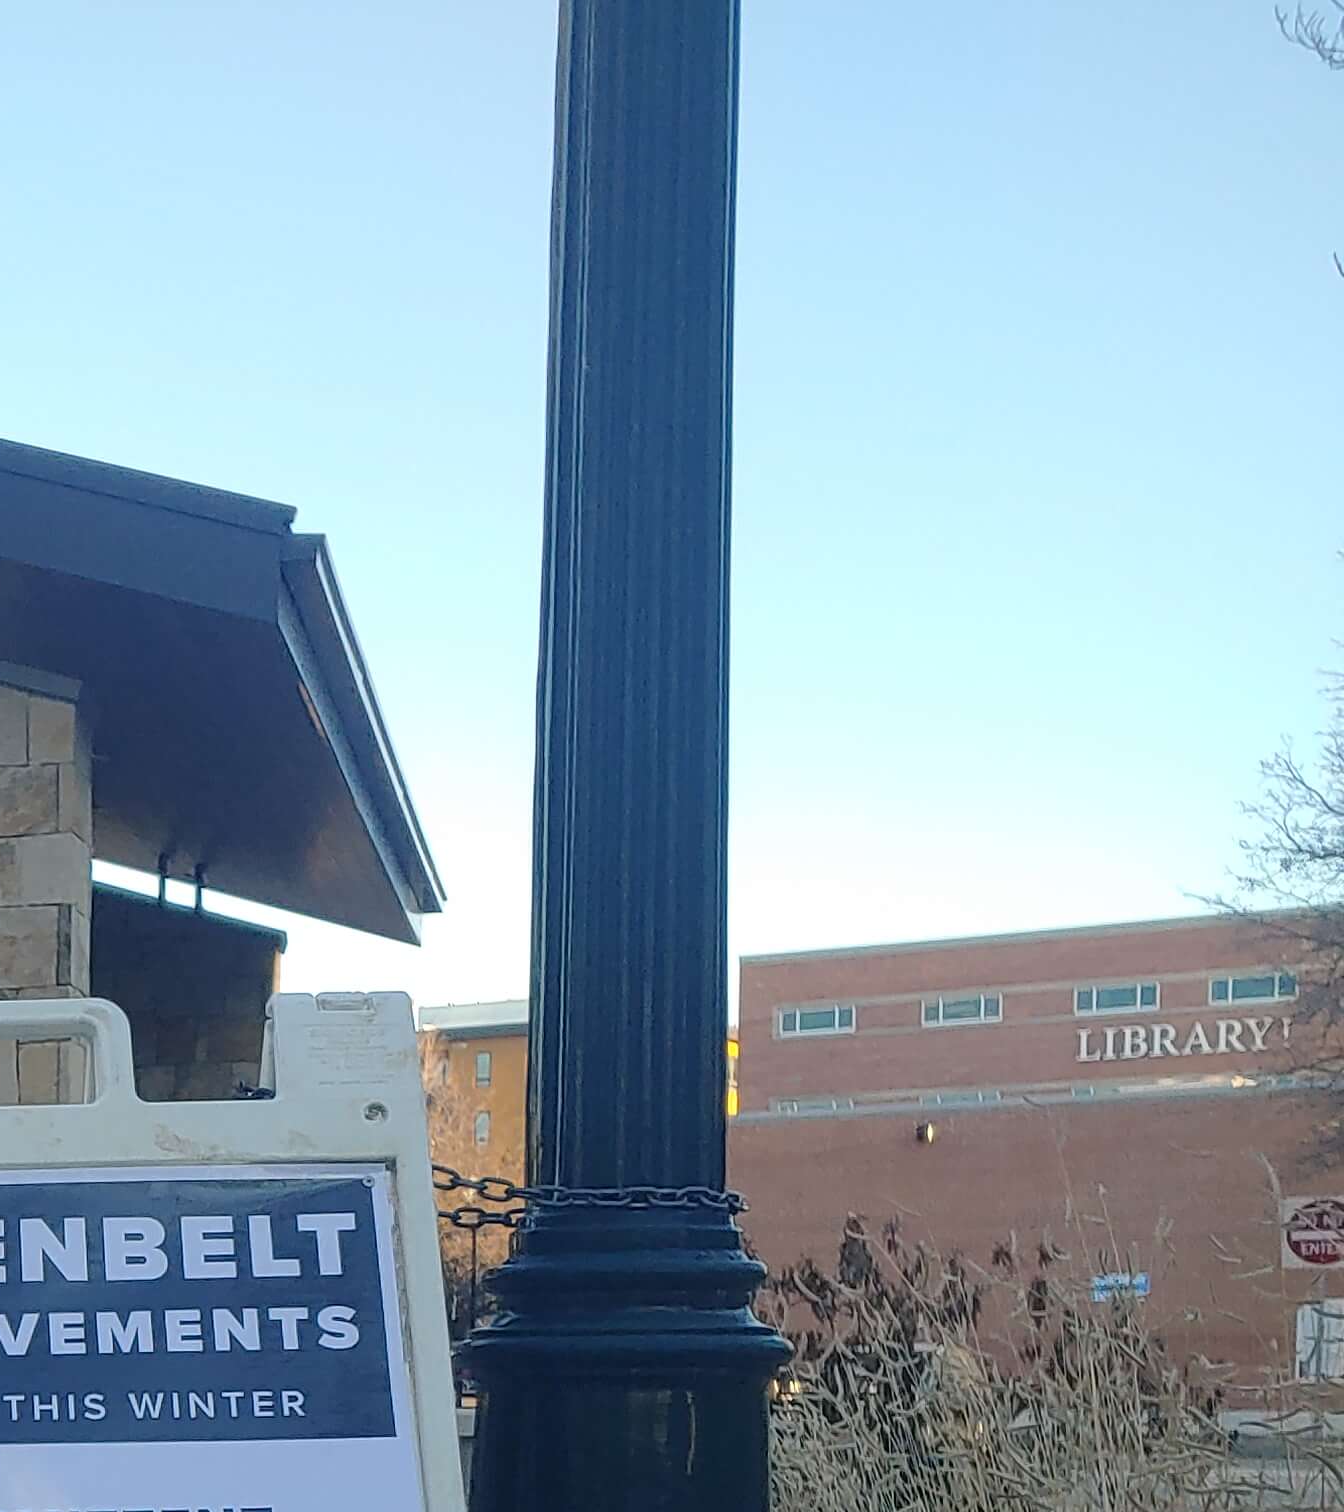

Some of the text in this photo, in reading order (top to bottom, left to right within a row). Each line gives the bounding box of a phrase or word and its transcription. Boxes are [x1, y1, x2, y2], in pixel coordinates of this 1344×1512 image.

[1076, 1016, 1293, 1062] LIBRARY!
[3, 1393, 106, 1422] THIS
[129, 1391, 307, 1420] WINTER
